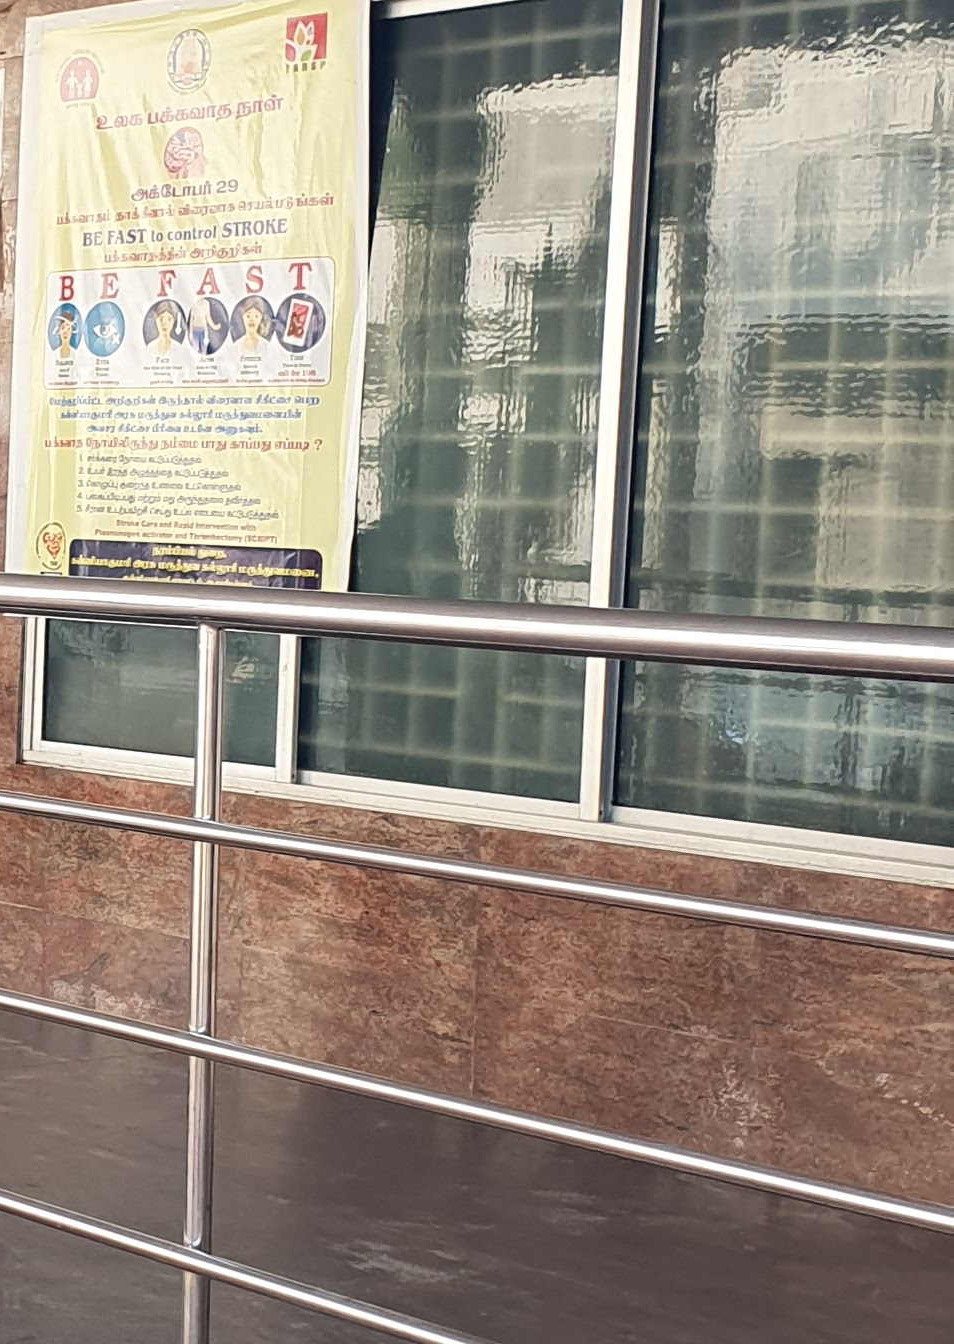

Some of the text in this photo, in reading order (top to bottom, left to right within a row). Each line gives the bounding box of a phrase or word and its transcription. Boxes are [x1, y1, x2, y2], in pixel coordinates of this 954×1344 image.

[96, 94, 284, 130] உலக பக்கவாத நாள்
[131, 179, 239, 201] அக்டோபர் 29
[83, 218, 288, 247] BE FAST to control STROKE
[59, 262, 312, 301] B E F A S T
[313, 439, 323, 451] ?
[95, 529, 140, 538] Plasminogen
[116, 519, 140, 527] Stroke
[141, 520, 159, 528] Care
[173, 522, 194, 530] Rapid
[195, 522, 239, 531] Intervention
